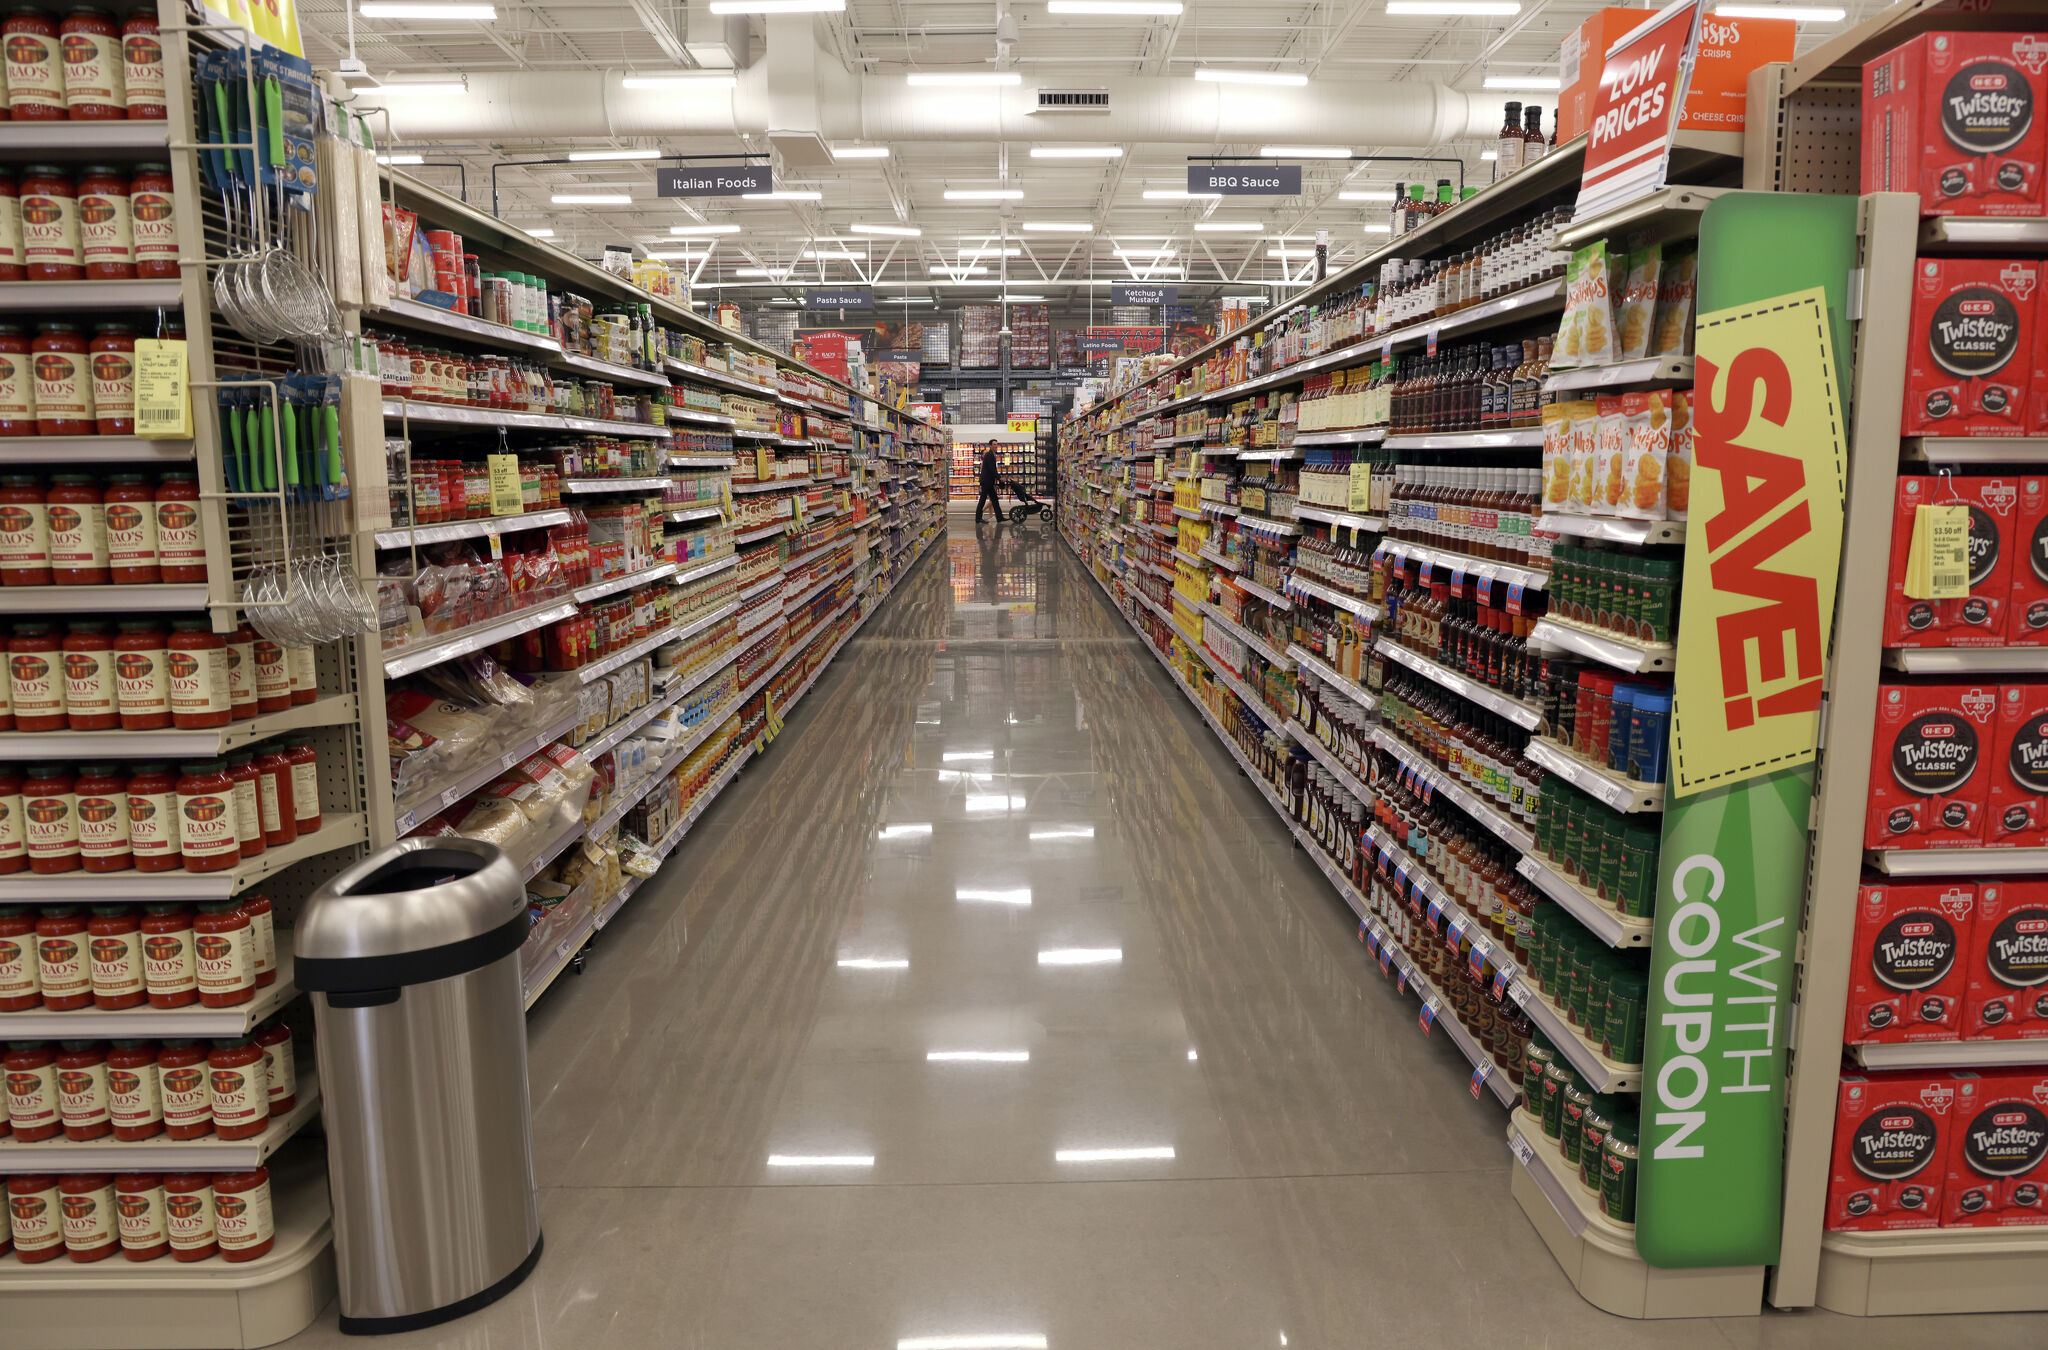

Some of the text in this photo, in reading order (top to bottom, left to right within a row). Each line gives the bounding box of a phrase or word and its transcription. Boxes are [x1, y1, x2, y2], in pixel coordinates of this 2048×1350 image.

[1702, 48, 1732, 58] CRISPS
[9, 65, 49, 78] RAO'S
[65, 65, 99, 78] RAO'S
[125, 65, 164, 78] RAO'S
[1610, 44, 1666, 102] LOW
[1950, 92, 2022, 121] Twisters
[1592, 82, 1667, 149] PRICES
[1692, 112, 1724, 122] CHEESE
[1726, 114, 1744, 122] CRIS
[1966, 117, 2010, 126] CLASSIC
[673, 178, 757, 189] Italian Foods
[1209, 177, 1280, 187] BBQ Sauce
[24, 227, 62, 237] RAO'S
[81, 225, 117, 237] RAO'S
[135, 223, 173, 235] RAO'S
[1093, 330, 1157, 340] TEXAS
[1938, 318, 2009, 344] Twisters
[1953, 342, 1996, 350] CLASSIC
[36, 383, 74, 394] RAO'S
[95, 382, 133, 393] RAO'S
[109, 531, 143, 542] RAO'S
[160, 530, 197, 541] RAO'S
[1692, 347, 1824, 731] SAVE!
[13, 681, 50, 693] RAO'S
[67, 680, 99, 691] RAO'S
[118, 680, 154, 690] RAO'S
[1901, 740, 1968, 766] Twisters
[1915, 762, 1956, 770] CLASSIC
[29, 823, 69, 835] RAO'S
[80, 823, 117, 834] RAO'S
[130, 823, 156, 833] AO'S
[187, 820, 226, 833] RAO'S
[1881, 938, 1947, 963] Twisters
[1996, 935, 2048, 960] Twiste
[41, 963, 79, 975] RAO'S
[92, 962, 129, 973] RAO'S
[147, 960, 184, 972] RAO'S
[197, 959, 232, 971] RAO'S
[1895, 959, 1934, 967] CLASSIC
[1654, 854, 1725, 1159] COUPON
[1721, 916, 1785, 1093] WITH
[60, 1093, 94, 1105] RAO'S
[166, 1090, 204, 1104] RAO'S
[212, 1092, 246, 1103] RAO'S
[1861, 1131, 1927, 1154] Twisters
[1973, 1127, 2041, 1151] Twisters
[13, 1217, 48, 1230] RAO'S
[64, 1217, 97, 1229] RAO'S
[119, 1217, 150, 1228] RAO'S
[169, 1216, 203, 1228] RAO'S
[216, 1216, 247, 1227] RAO'S
